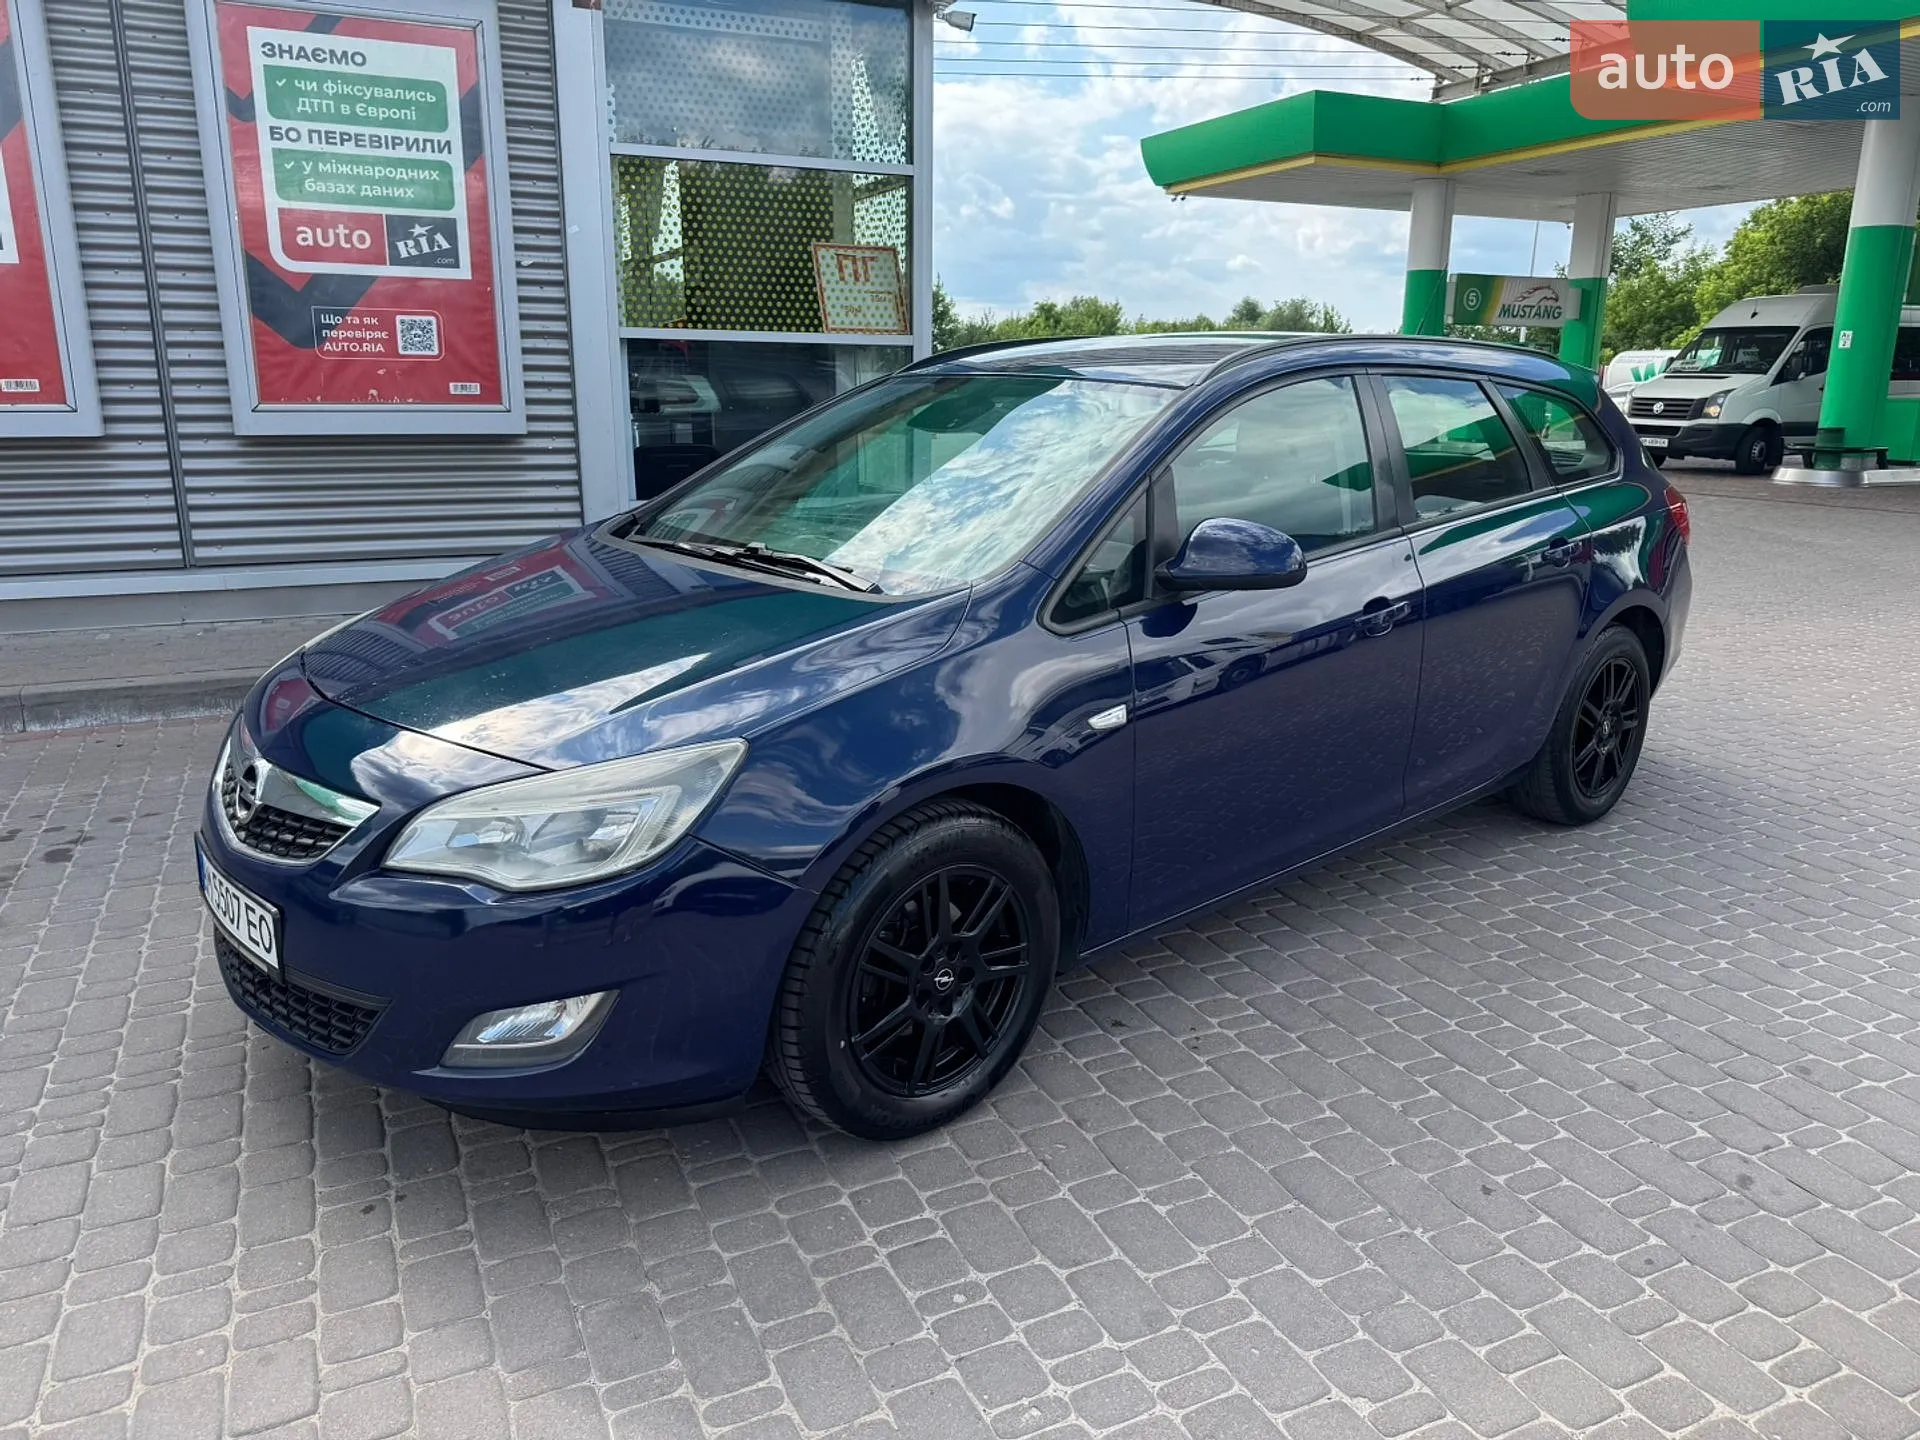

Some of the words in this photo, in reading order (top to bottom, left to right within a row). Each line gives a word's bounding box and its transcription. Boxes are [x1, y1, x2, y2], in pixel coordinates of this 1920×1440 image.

[261, 41, 367, 67] ЗНАЄМО
[294, 80, 318, 92] чи
[323, 79, 436, 103] фіксувались
[296, 97, 335, 114] ДТП
[340, 105, 350, 115] в
[355, 103, 416, 121] Європі
[269, 125, 302, 143] БО
[308, 128, 452, 155] ПЕРЕВІРИЛИ
[302, 161, 313, 175] у
[318, 159, 440, 181] міжнародних
[304, 178, 356, 195] базах
[360, 183, 415, 198] даних
[296, 223, 371, 250] auto
[394, 232, 452, 259] RIA
[434, 256, 455, 265] .com
[1468, 293, 1476, 305] 5
[321, 313, 343, 325] Що
[345, 316, 360, 324] та
[363, 317, 379, 325] як
[1498, 304, 1562, 320] MUSTANG
[322, 329, 390, 340] перевіряє
[323, 343, 386, 353] AUTO.RIA
[244, 902, 273, 954] EO
